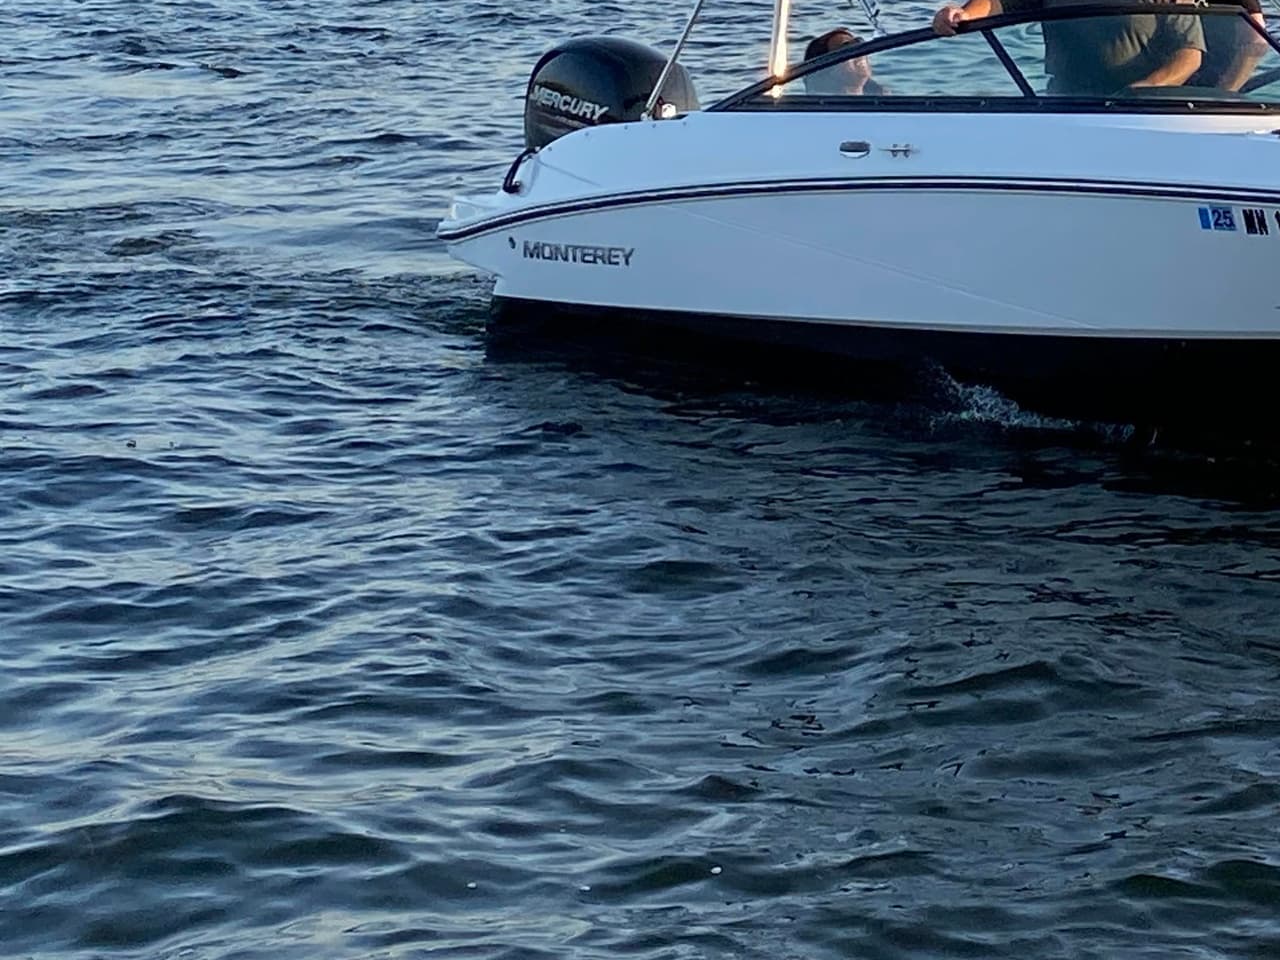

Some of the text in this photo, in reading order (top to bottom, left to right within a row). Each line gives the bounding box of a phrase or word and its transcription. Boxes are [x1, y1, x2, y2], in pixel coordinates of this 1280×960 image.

[528, 84, 610, 121] MERCURY
[1211, 208, 1235, 228] 25
[523, 240, 635, 266] MONTEREY
